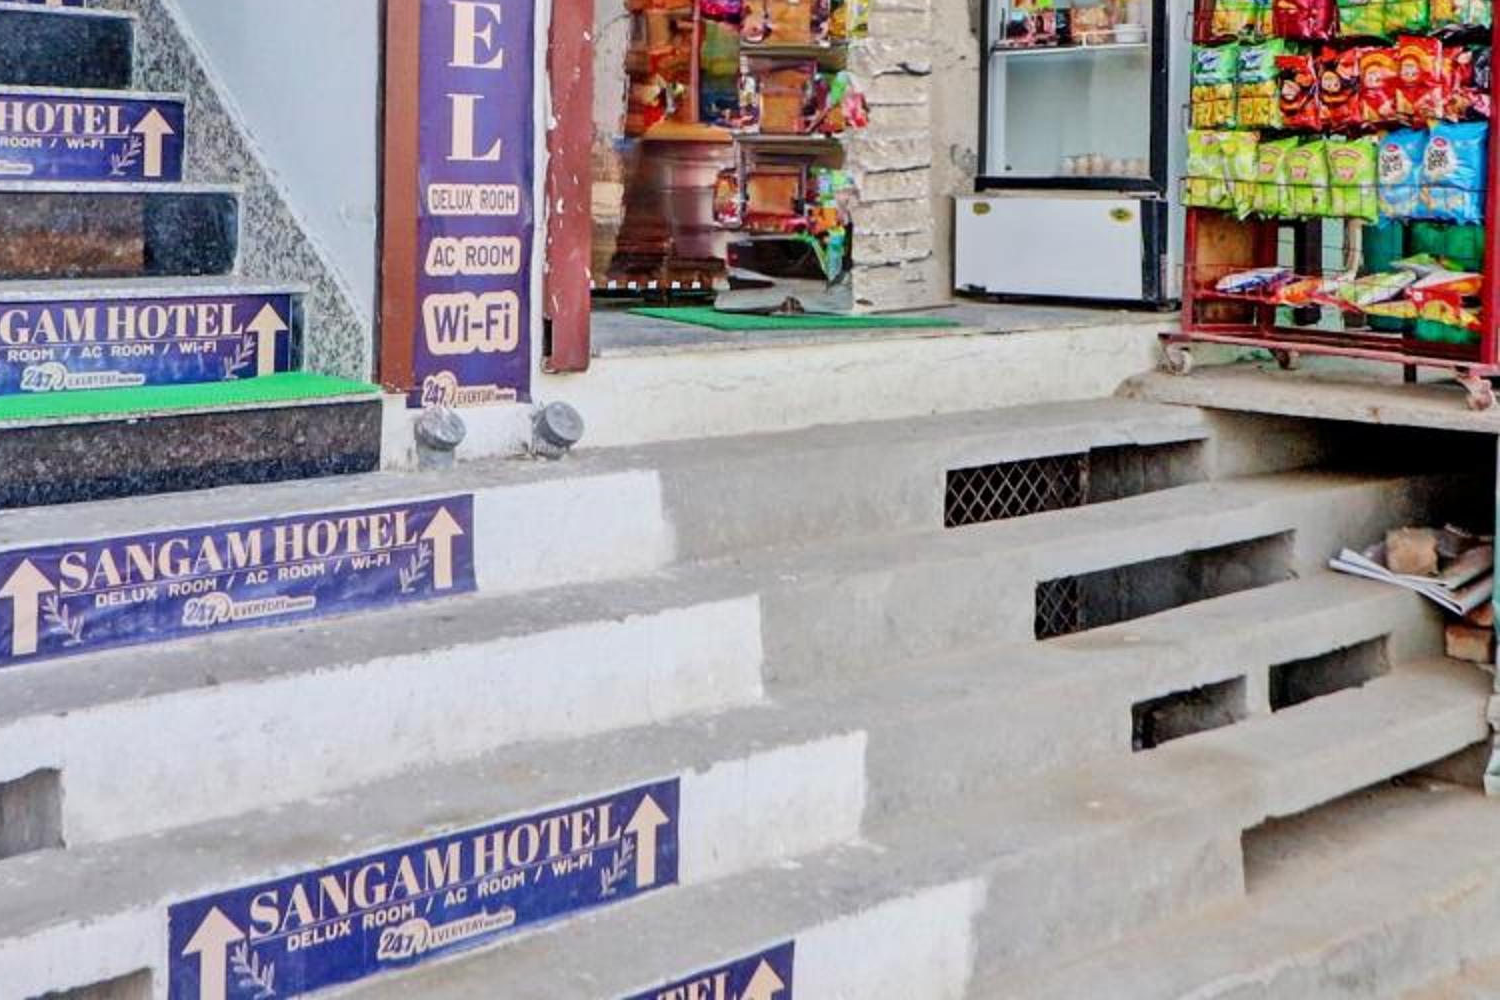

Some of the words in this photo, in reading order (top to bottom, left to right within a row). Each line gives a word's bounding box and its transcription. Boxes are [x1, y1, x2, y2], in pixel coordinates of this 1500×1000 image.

[0, 136, 42, 148] ROOM
[431, 189, 473, 211] DELUX
[480, 188, 516, 210] ROOM
[433, 246, 455, 267] AC
[466, 245, 514, 267] ROOM
[103, 303, 243, 340] HOTEL
[433, 302, 510, 343] Wi-Fi
[7, 347, 54, 362] ROOM
[81, 345, 102, 359] AC
[111, 343, 154, 357] ROOM
[59, 533, 261, 594] SANGAM
[273, 511, 418, 563] HOTEL
[95, 587, 157, 608] DELUX
[169, 577, 217, 597] ROOM
[246, 571, 268, 586] AC
[278, 564, 325, 581] ROOM
[249, 842, 463, 939] SANGAM
[474, 803, 622, 879] HOTEL
[287, 924, 351, 952] DELUX
[362, 902, 415, 929] ROOM
[444, 884, 467, 908] AC
[480, 870, 525, 897] ROOM
